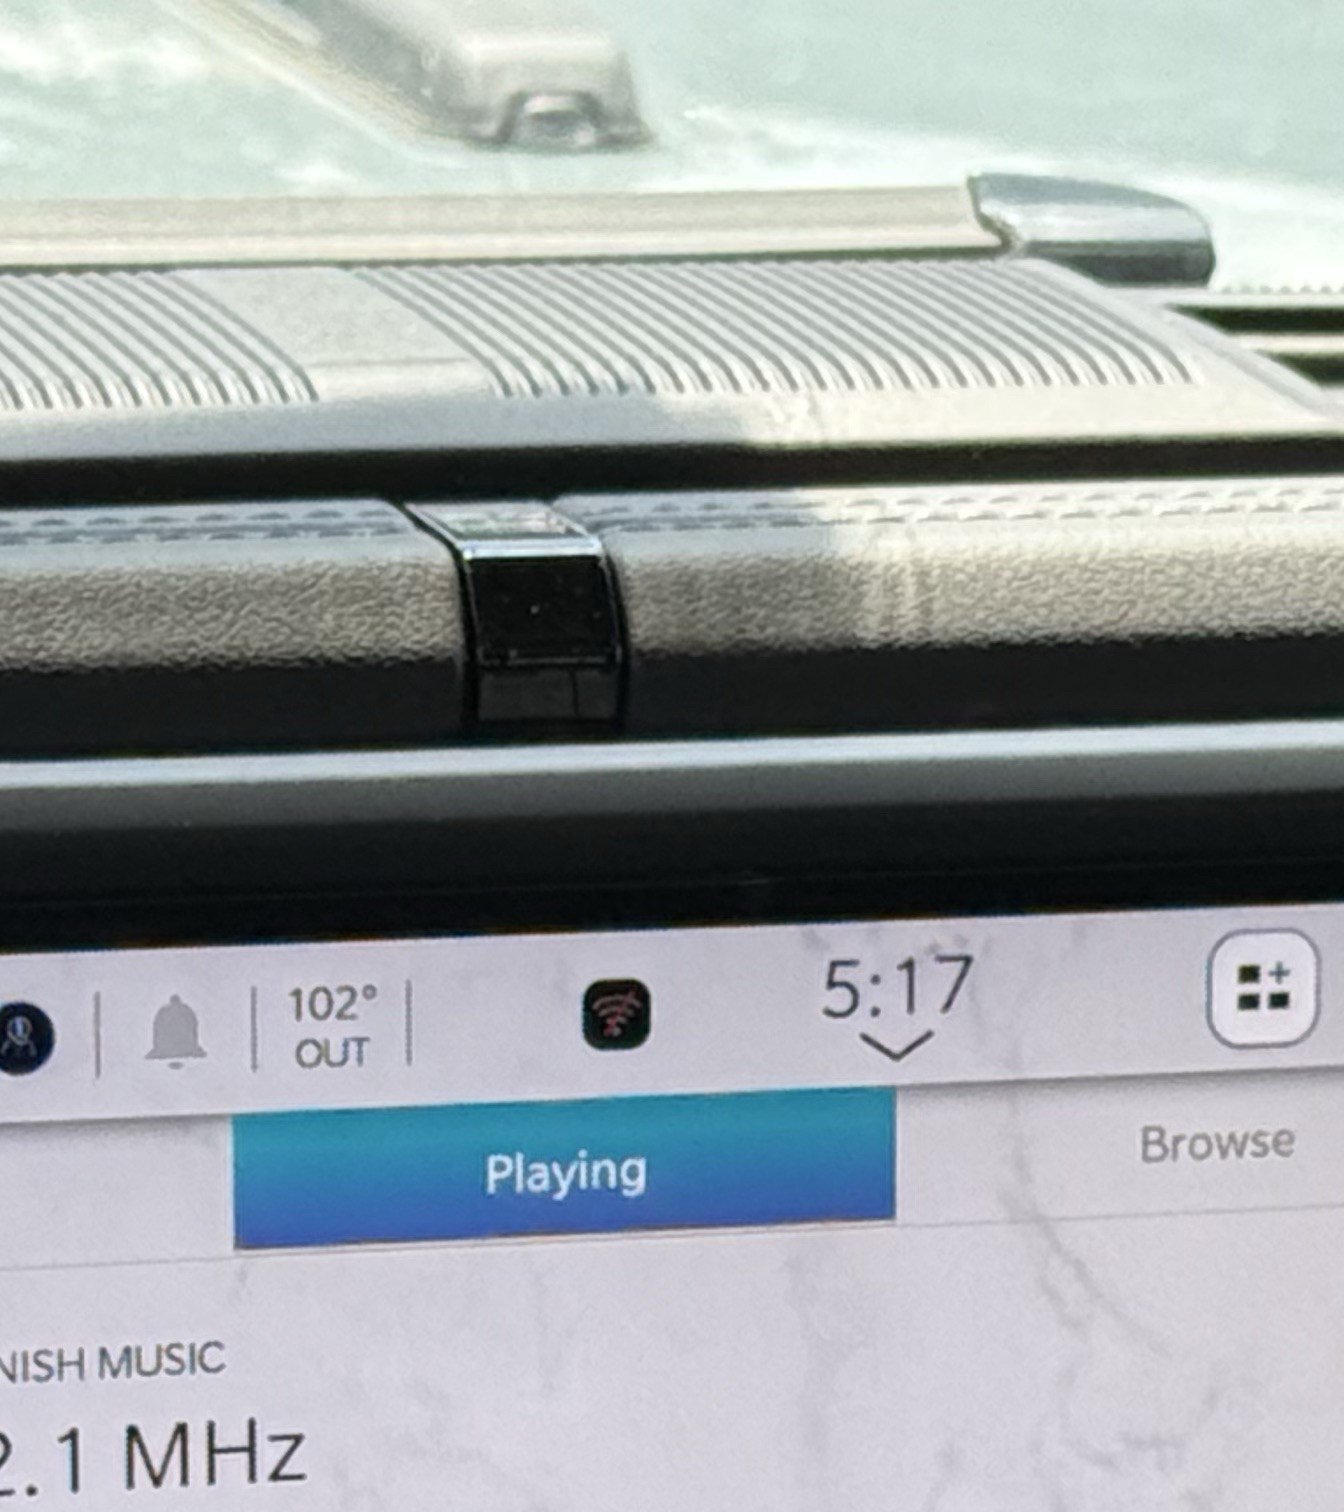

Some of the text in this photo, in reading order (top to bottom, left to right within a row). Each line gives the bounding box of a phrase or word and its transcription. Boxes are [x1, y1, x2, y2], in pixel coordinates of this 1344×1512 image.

[288, 983, 378, 1022] 102°
[823, 952, 975, 1020] 5:17
[295, 1035, 369, 1070] OUT
[1140, 1122, 1297, 1165] Browse
[485, 1150, 648, 1200] Playing
[98, 1340, 227, 1380] MUSIC
[125, 1417, 307, 1491] MHz
